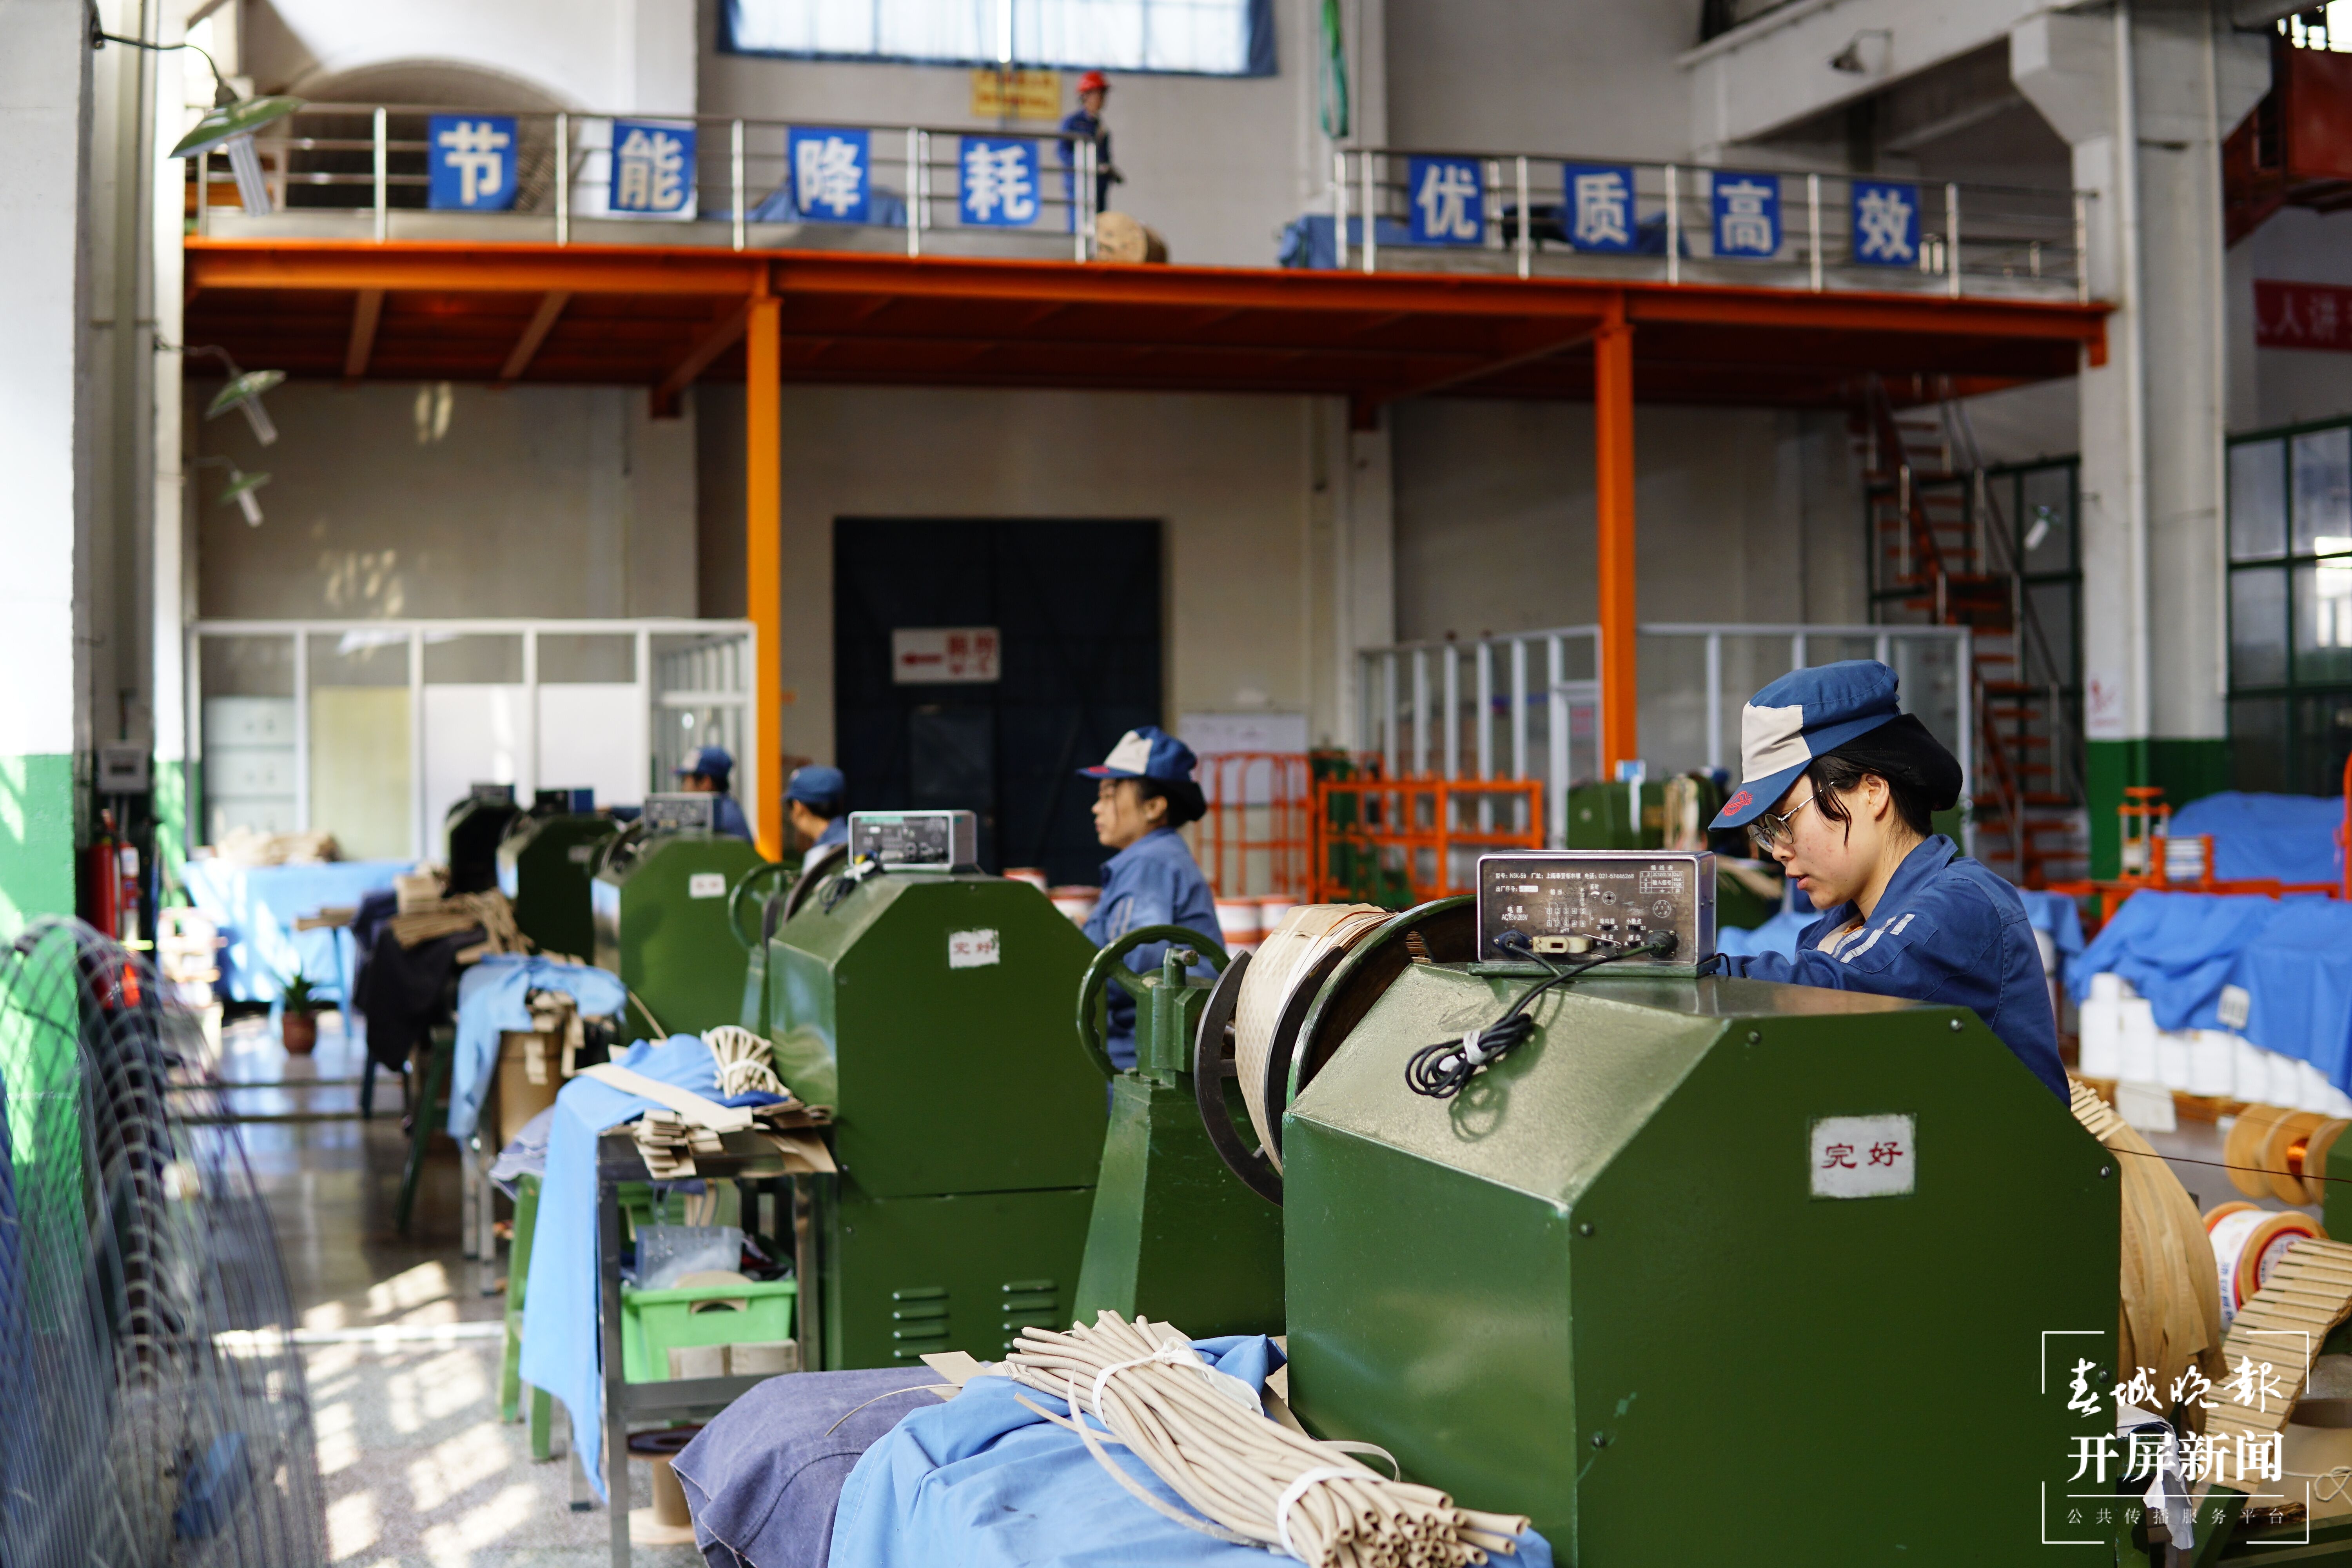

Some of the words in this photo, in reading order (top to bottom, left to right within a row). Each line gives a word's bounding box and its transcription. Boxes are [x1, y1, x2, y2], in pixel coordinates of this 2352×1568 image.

[439, 122, 510, 205] 节
[618, 130, 685, 211] 能
[797, 136, 863, 216] 降
[964, 142, 1036, 221] 耗
[1417, 165, 1480, 239] 优
[1574, 172, 1630, 245] 质
[1719, 180, 1775, 252] 高
[1859, 189, 1914, 259] 效
[1821, 1141, 1903, 1169] 完好
